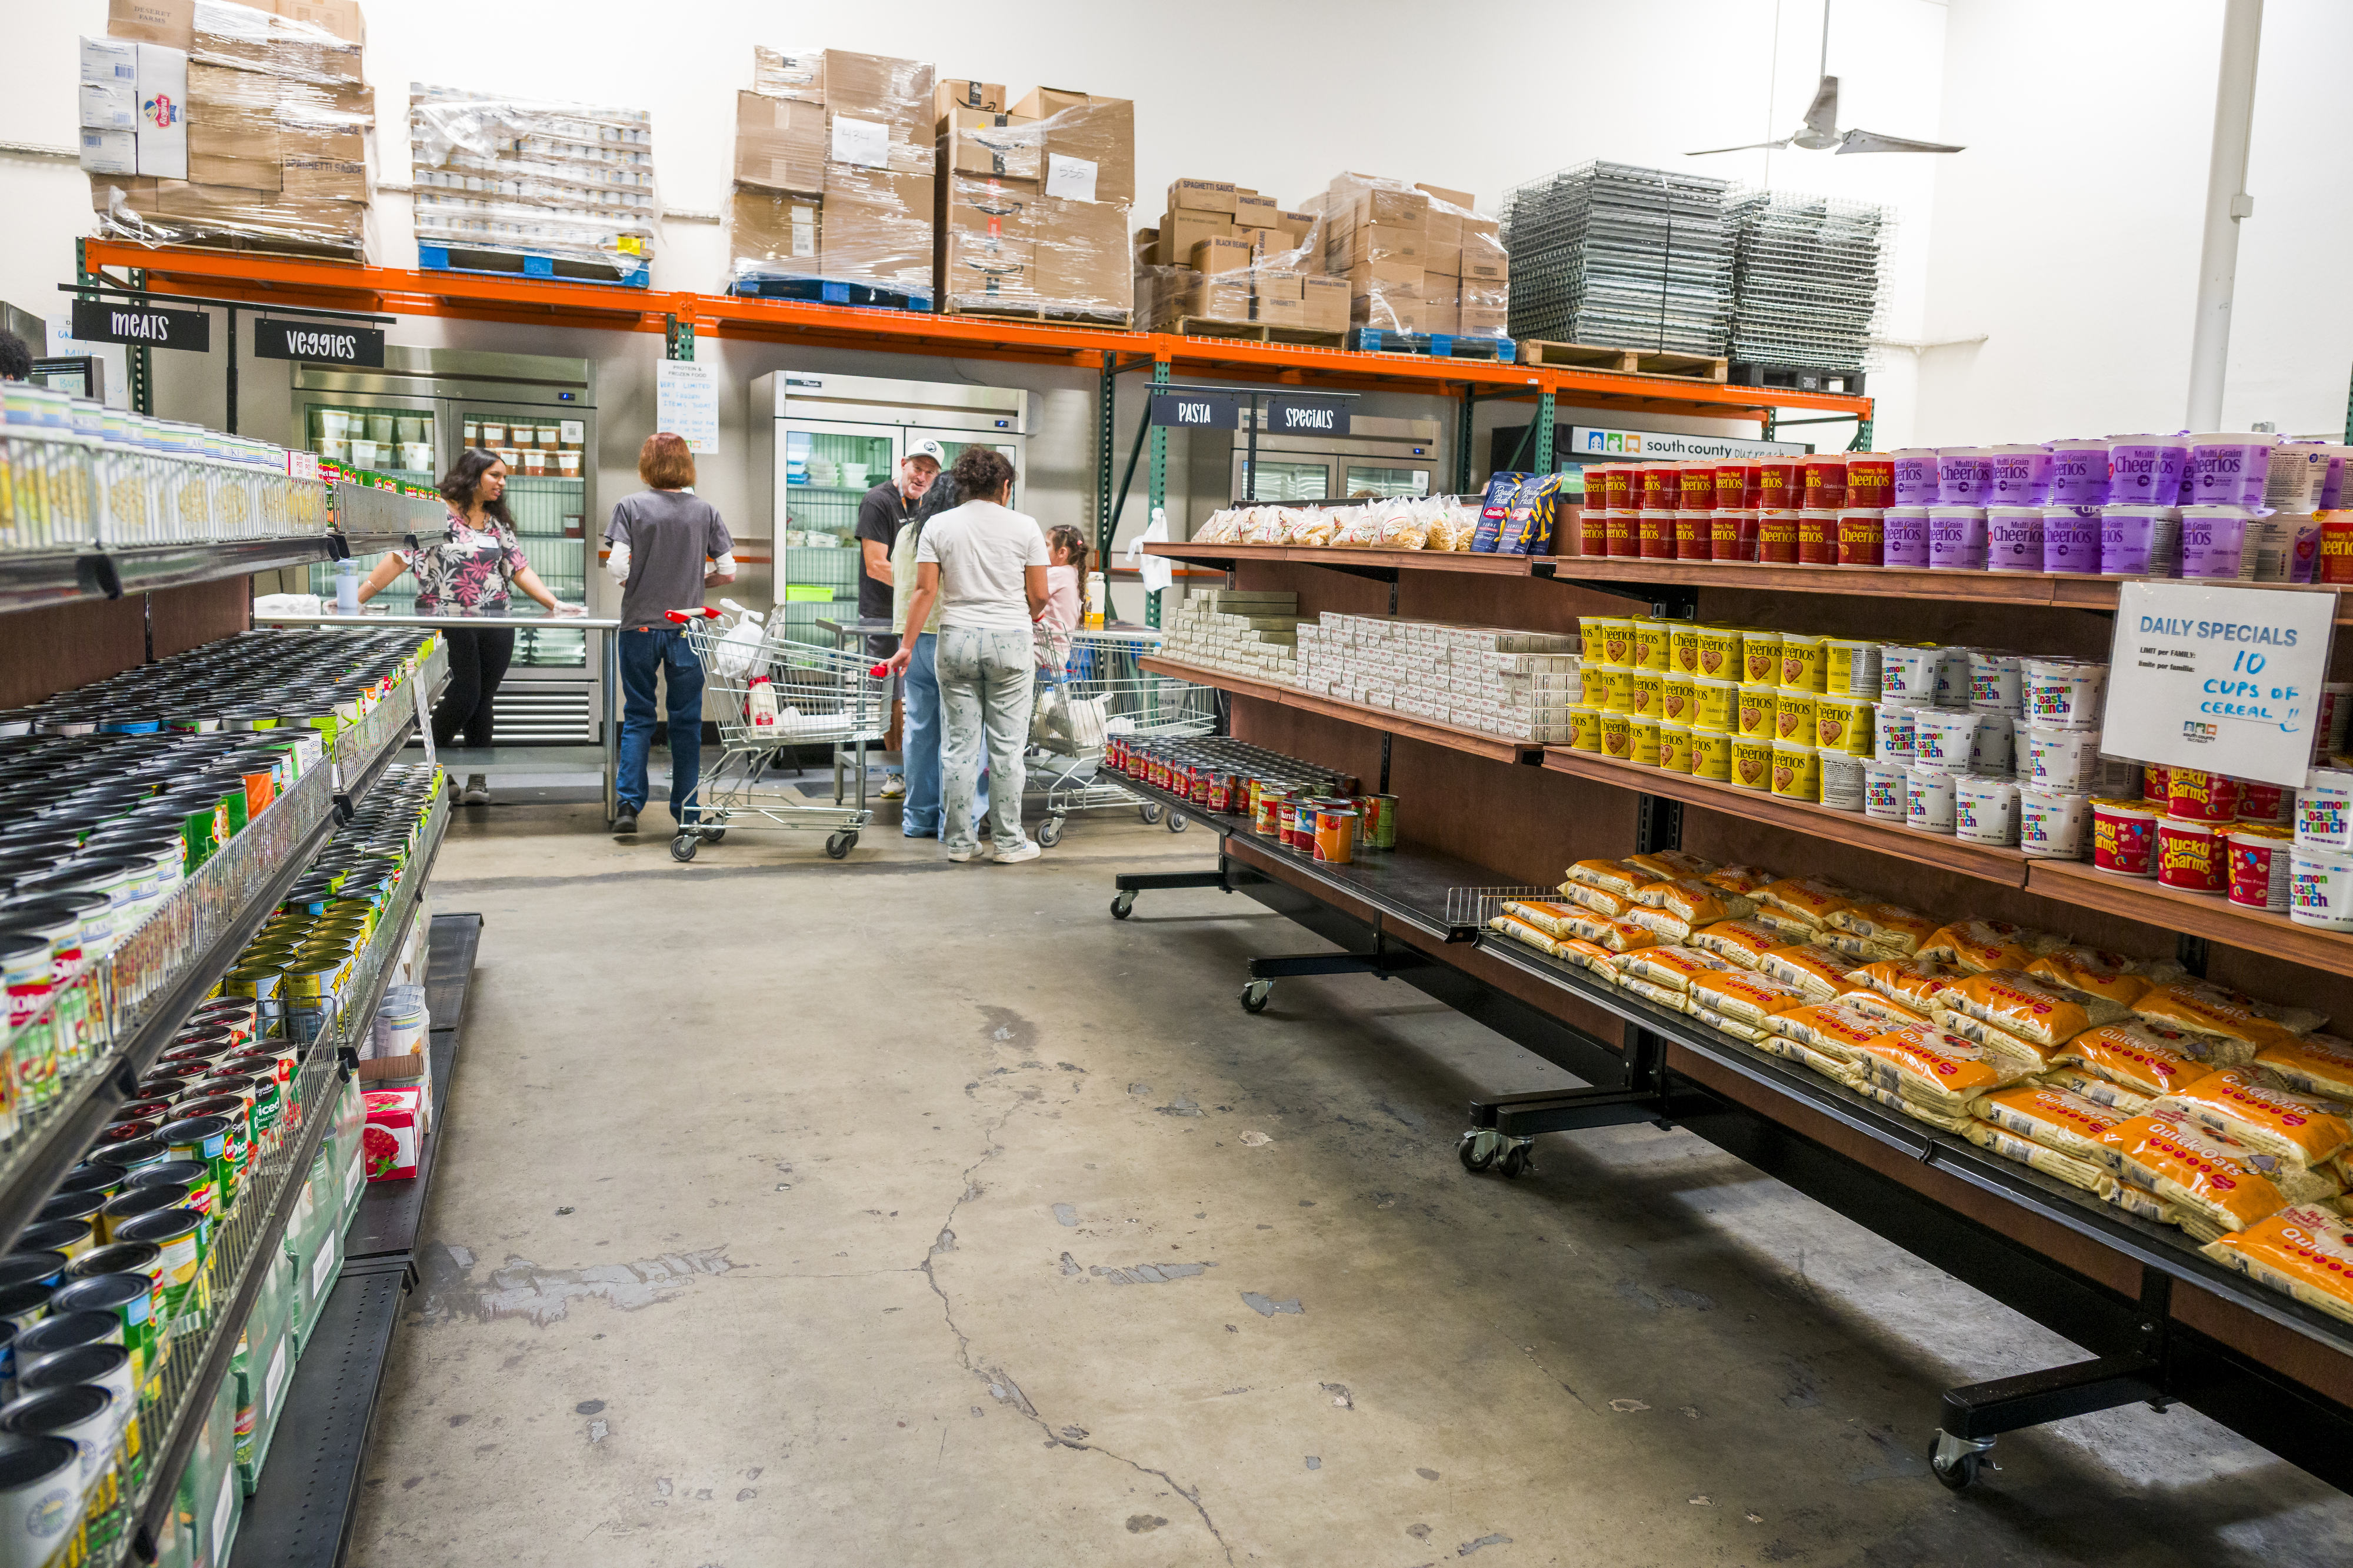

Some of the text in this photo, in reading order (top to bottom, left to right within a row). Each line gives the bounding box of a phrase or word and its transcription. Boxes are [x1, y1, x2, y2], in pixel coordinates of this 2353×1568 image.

[134, 6, 171, 18] DESERET
[139, 14, 166, 24] FARMS
[842, 129, 869, 142] 434
[335, 163, 362, 175] SAUCE
[1183, 181, 1235, 193] SPAGHETTI SAUCE
[1239, 196, 1276, 207] SPAGHETTI SAUCE
[1287, 212, 1314, 222] MACARONI
[1215, 239, 1231, 247] BLACK
[1232, 241, 1248, 249] BEANS
[1270, 299, 1297, 308] SPAGHETTI
[1178, 402, 1211, 423] PASTA
[1647, 439, 1685, 453] south
[1688, 443, 1732, 459] county
[2134, 450, 2176, 459] Multi Grain
[2200, 449, 2242, 458] Multi Grain
[2009, 458, 2029, 466] Grain
[2068, 454, 2087, 462] Grain
[2115, 455, 2174, 474] Cheerios
[1858, 468, 1875, 476] Honey
[1941, 465, 1990, 481] Cheerios
[1848, 472, 1890, 488] Cheerios
[1495, 485, 1515, 499] Ready
[1522, 486, 1540, 498] Ready
[1492, 494, 1509, 505] Pasta
[1519, 495, 1534, 505] Pasta
[1485, 509, 1506, 518] Barilla
[1853, 523, 1870, 532] Honey
[1945, 521, 1963, 529] Grain
[2055, 521, 2093, 529] Multi Grain
[1760, 529, 1797, 543] Cheerios
[1840, 528, 1884, 543] Cheerios
[1994, 526, 2044, 542] Cheerios
[2327, 531, 2346, 539] Honey
[2139, 616, 2298, 647] DAILY SPECIALS
[2140, 646, 2157, 655] LIMIT
[2170, 649, 2196, 659] FAMILY:
[2169, 663, 2195, 672] familia:
[2233, 650, 2266, 675] 10
[2032, 685, 2072, 695] Cinnamon
[2203, 678, 2299, 700] CUPS OF
[2037, 693, 2064, 705] Toast
[2033, 700, 2071, 714] Crunch
[2200, 701, 2273, 719] CEREAL
[1733, 744, 1773, 761] Cheerios
[1192, 772, 1205, 782] Vine
[2171, 766, 2208, 788] Lucky
[1868, 788, 1889, 798] Toast
[2168, 782, 2211, 804] Charms
[1867, 795, 1897, 806] Crunch
[2298, 798, 2350, 810] Cinnamon
[2304, 809, 2339, 822] Toast
[2299, 819, 2348, 833] Crunch
[2169, 837, 2212, 859] Lucky
[2164, 852, 2212, 875] Charms
[1754, 930, 1777, 943] Oats
[1728, 975, 1781, 996] Quick Oats
[1989, 975, 2059, 1003] Quick Oats
[1817, 1007, 1878, 1037] Quick Oats
[1899, 1031, 1966, 1063] Quick Oats
[2099, 1029, 2179, 1064] Quick Oats
[2036, 1092, 2117, 1127] Quick Oats
[2271, 1096, 2314, 1116] Oats
[2148, 1123, 2245, 1176] Quick Oats
